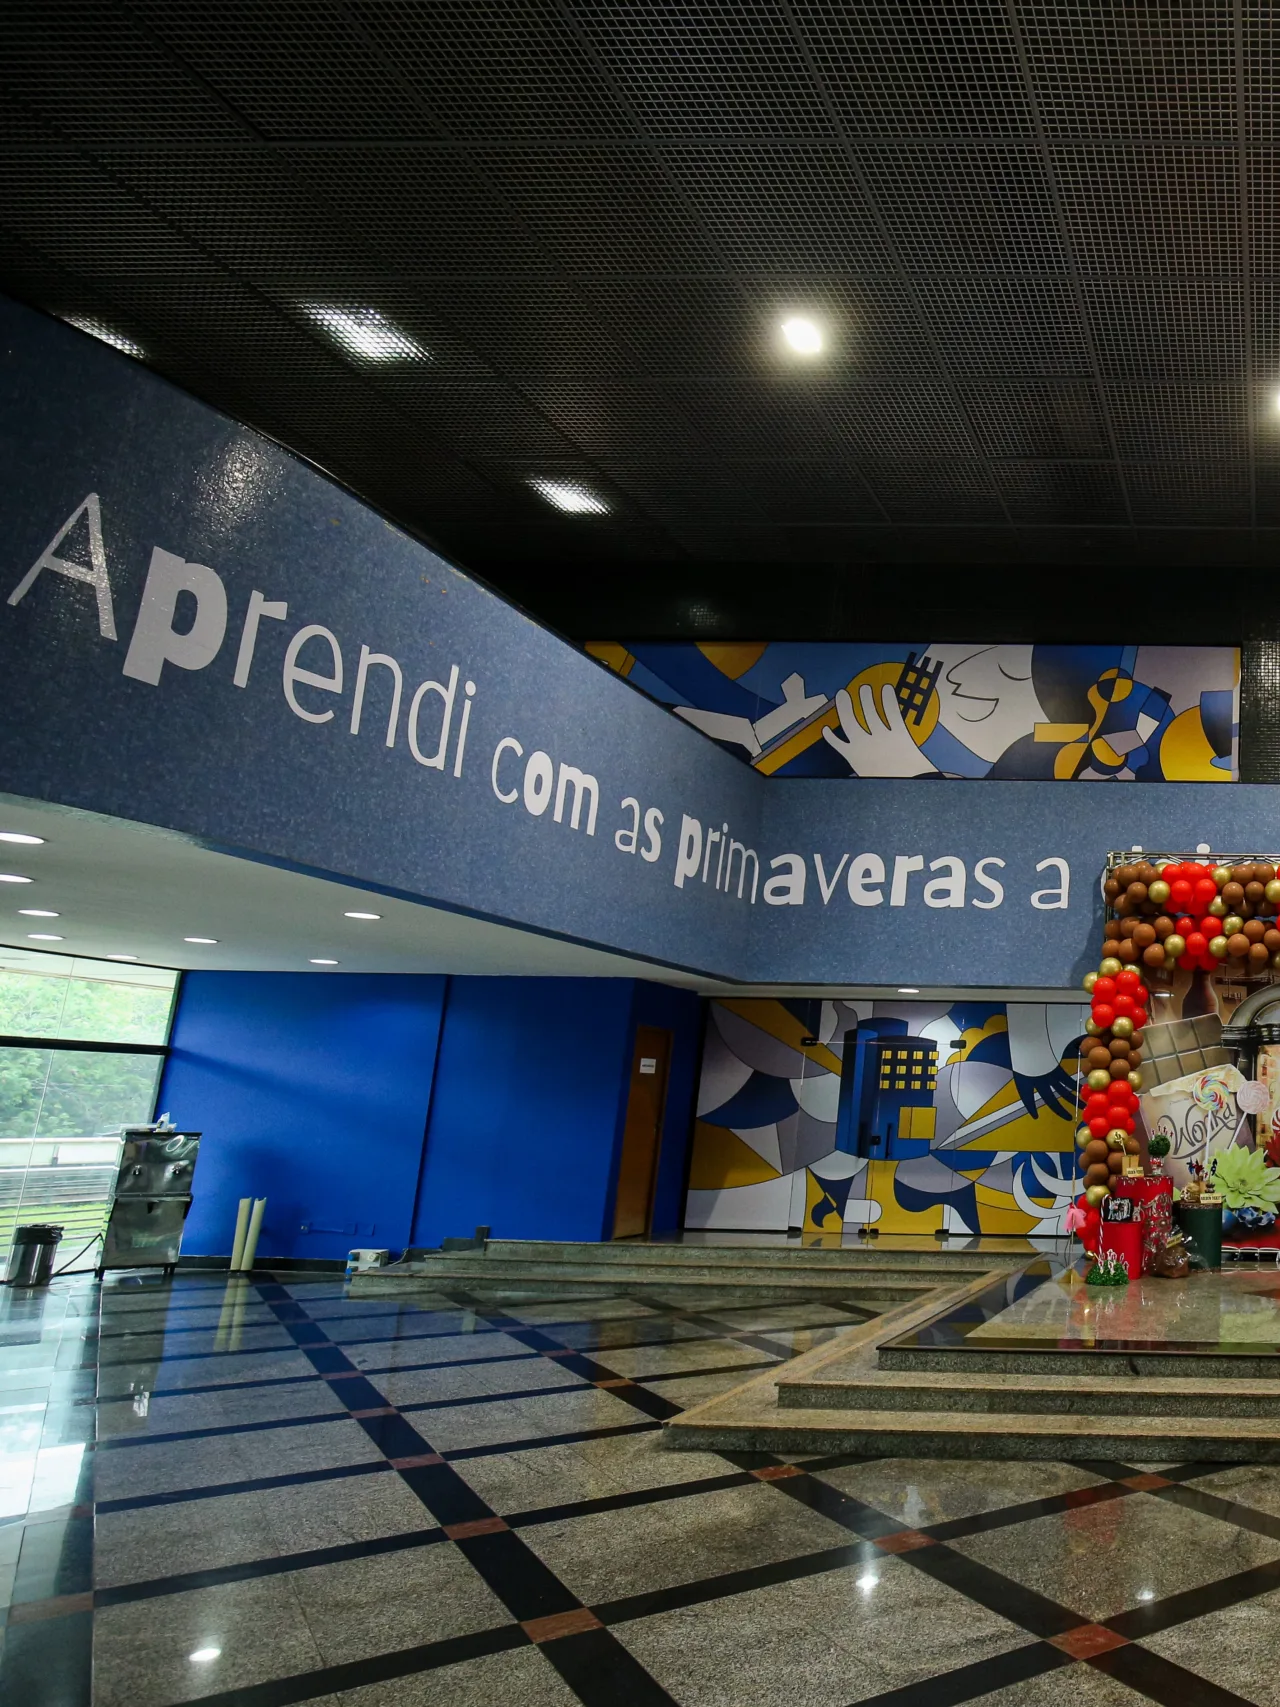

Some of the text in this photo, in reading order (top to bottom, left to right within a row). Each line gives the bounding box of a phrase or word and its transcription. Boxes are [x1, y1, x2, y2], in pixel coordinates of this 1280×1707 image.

[8, 492, 478, 778] Aprendi
[491, 737, 600, 837] com
[614, 797, 664, 863] as
[674, 813, 1006, 910] primaveras
[1030, 857, 1070, 910] a
